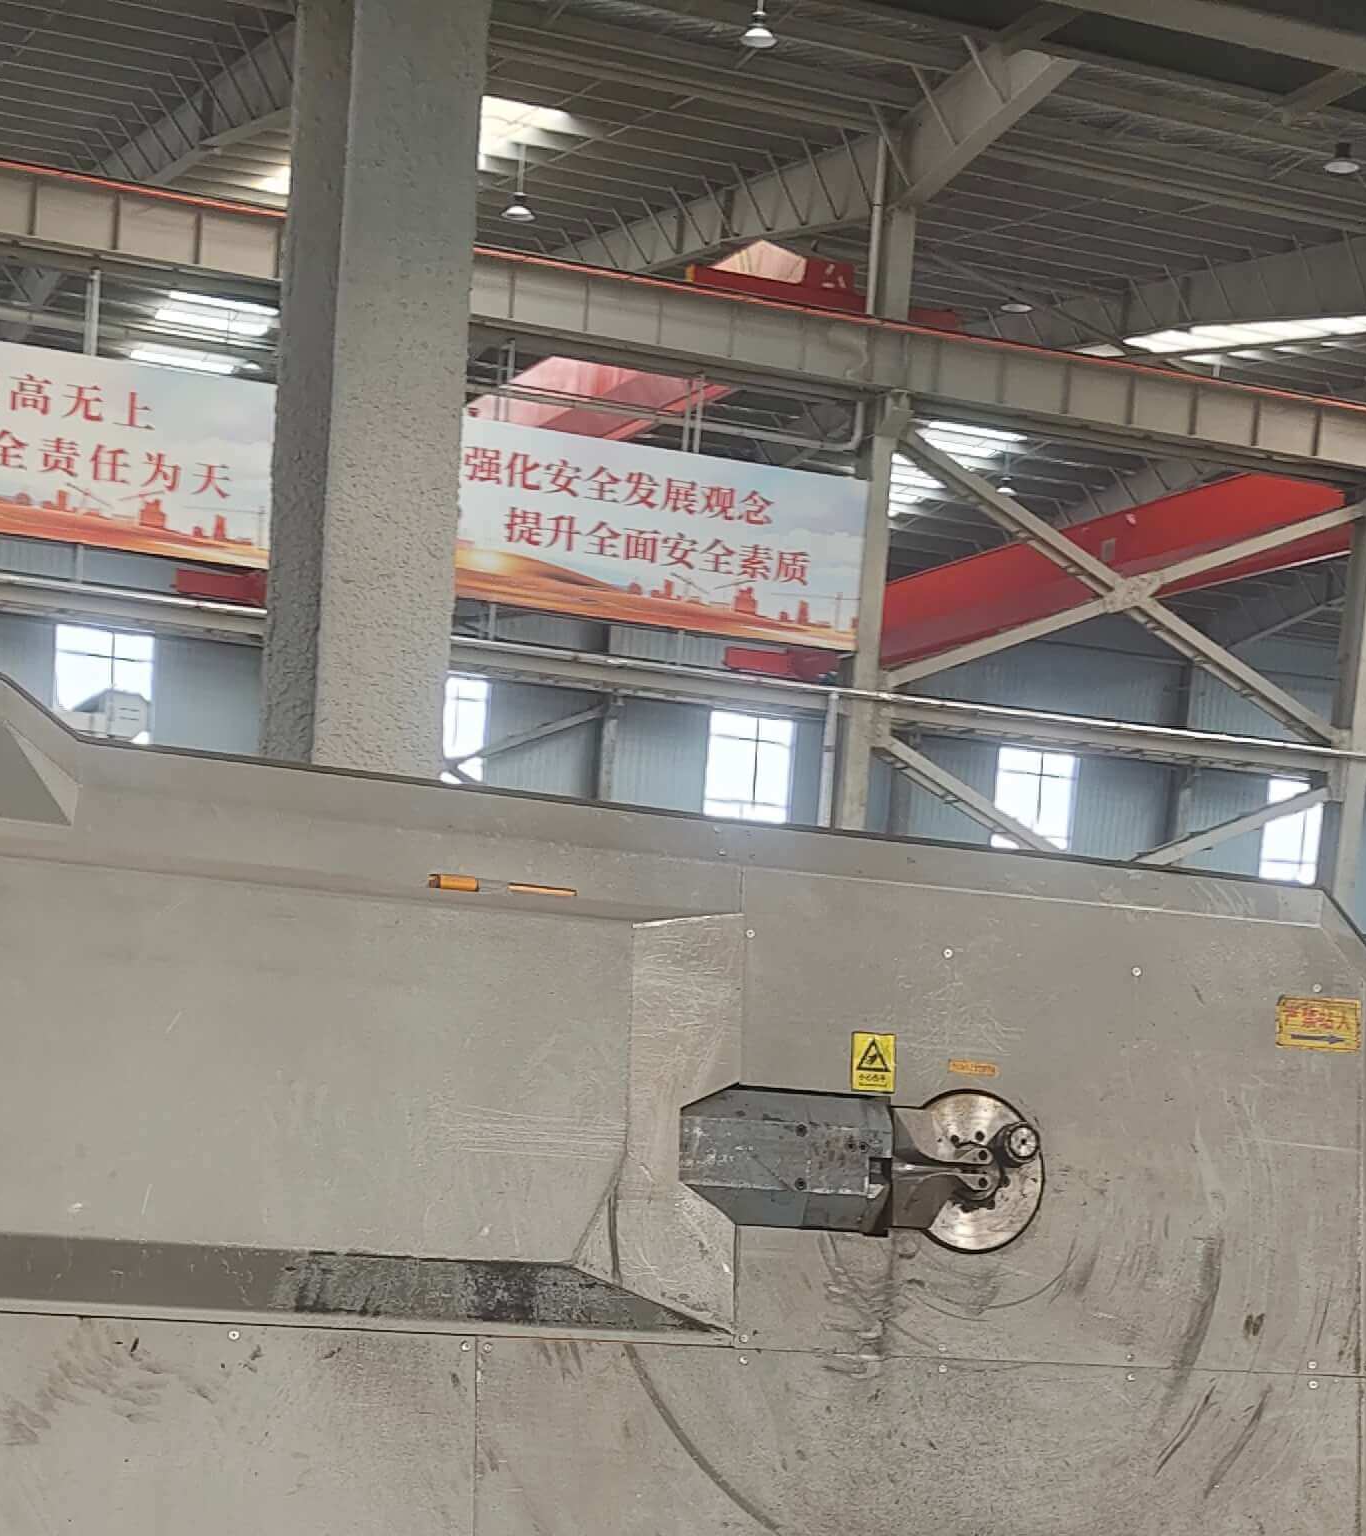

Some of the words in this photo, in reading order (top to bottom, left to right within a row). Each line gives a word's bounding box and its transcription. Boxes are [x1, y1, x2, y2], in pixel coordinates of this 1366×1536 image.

[464, 446, 773, 525] 强化安全发展观念
[504, 507, 810, 586] 提升全面安全素质
